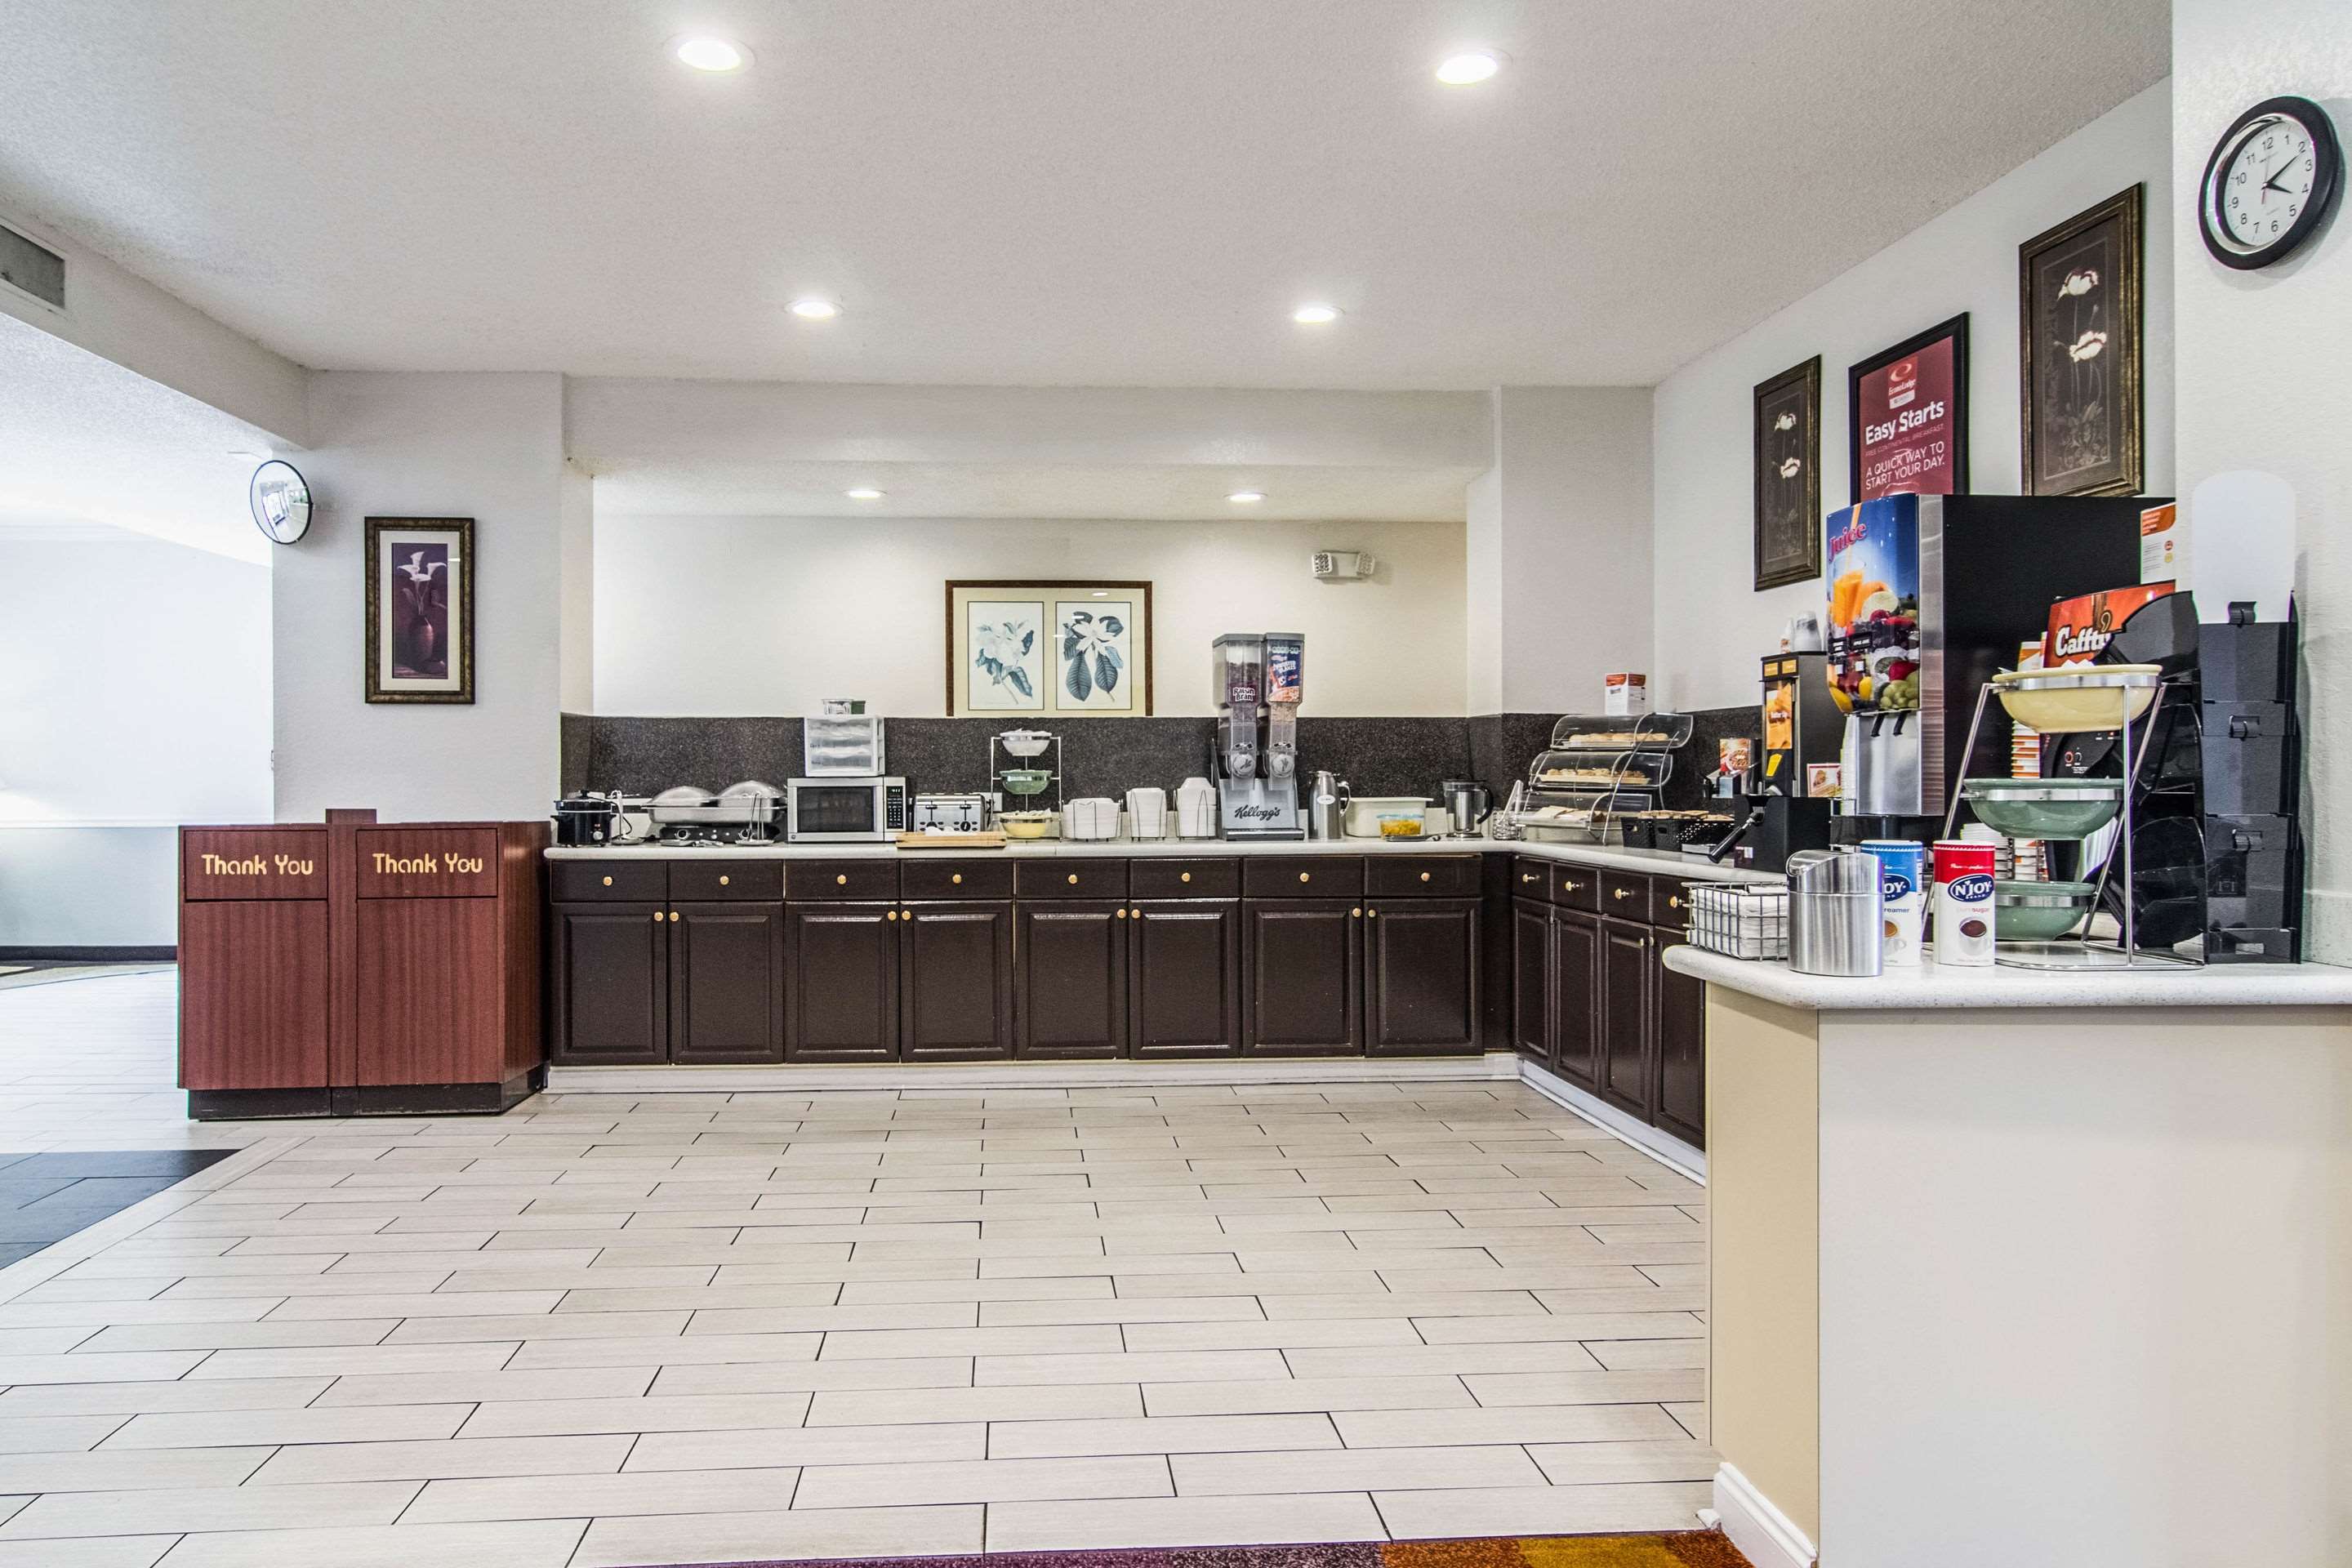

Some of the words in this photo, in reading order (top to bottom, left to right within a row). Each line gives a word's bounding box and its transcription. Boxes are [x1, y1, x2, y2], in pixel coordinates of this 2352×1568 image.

[2262, 136, 2274, 150] 12
[2284, 135, 2290, 145] 1
[2298, 141, 2305, 153] 2
[2246, 154, 2256, 166] 11
[2305, 159, 2313, 172] 3
[2236, 172, 2247, 185] 10
[2301, 184, 2310, 194] 4
[2231, 197, 2239, 209] 9
[2289, 204, 2296, 217] 5
[2240, 213, 2247, 225] 8
[2253, 221, 2261, 234] 7
[2271, 220, 2278, 232] 6
[1865, 418, 1896, 445] Easy
[1898, 401, 1944, 431] Starts
[1866, 467, 1873, 478] A
[1873, 453, 1903, 474] QUICK
[1905, 447, 1927, 464] WAY
[1930, 441, 1944, 455] TO
[1866, 471, 1892, 490] START
[1895, 463, 1921, 479] YOUR
[1923, 454, 1945, 471] DAY.
[1829, 523, 1867, 564] Juice
[1232, 687, 1255, 696] Raisin
[1235, 804, 1281, 821] Kellogg's
[202, 854, 267, 875] Thank
[274, 855, 314, 875] You
[372, 853, 437, 873] Thank
[445, 853, 483, 873] You
